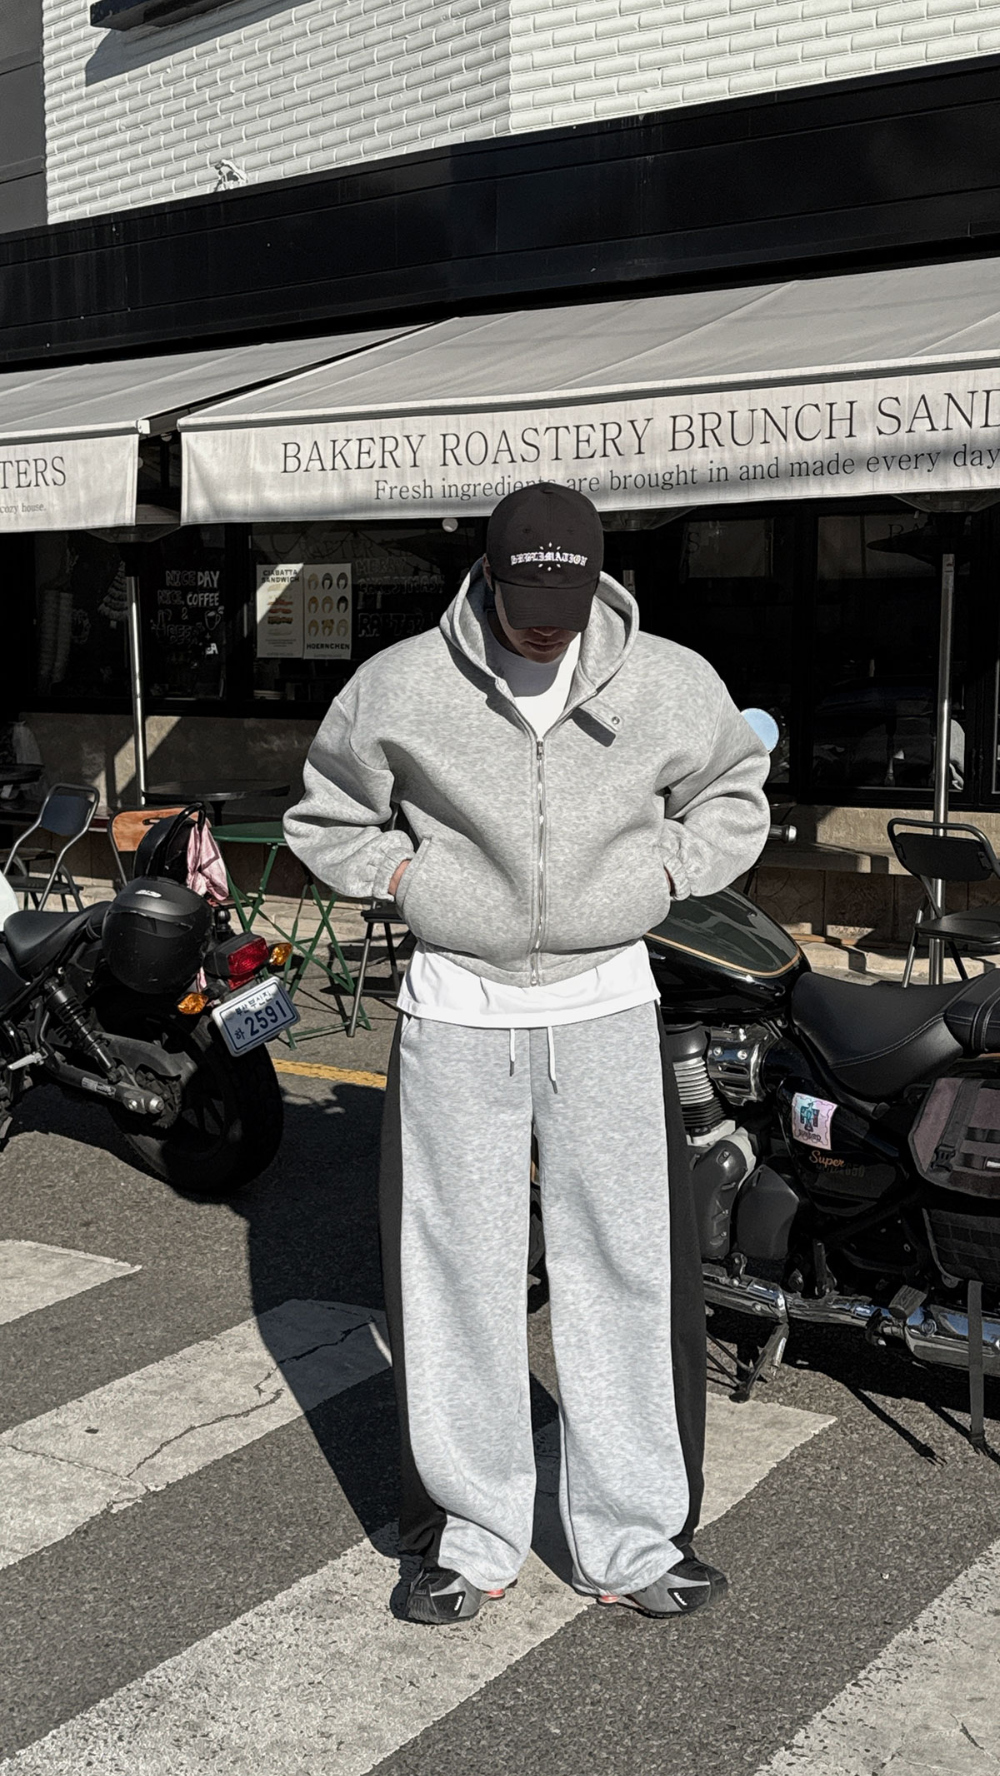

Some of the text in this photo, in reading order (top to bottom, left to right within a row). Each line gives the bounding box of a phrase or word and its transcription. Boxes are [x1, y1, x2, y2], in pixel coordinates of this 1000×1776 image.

[281, 434, 426, 473] BAKERY
[440, 417, 653, 466] ROASTERY
[668, 400, 858, 452] BRUNCH
[374, 478, 433, 500] Fresh
[566, 474, 600, 492] are
[610, 463, 698, 491] brought
[707, 459, 729, 484] in
[738, 456, 780, 482] and
[789, 452, 855, 477] made
[866, 450, 942, 473] every
[953, 443, 1000, 470] day
[197, 570, 220, 588] DAY
[262, 569, 299, 577] CIABATTA
[186, 592, 219, 607] COFFEE
[306, 642, 351, 650] HOERNCHEN
[244, 1000, 287, 1037] 2591
[808, 1149, 846, 1169] Super
